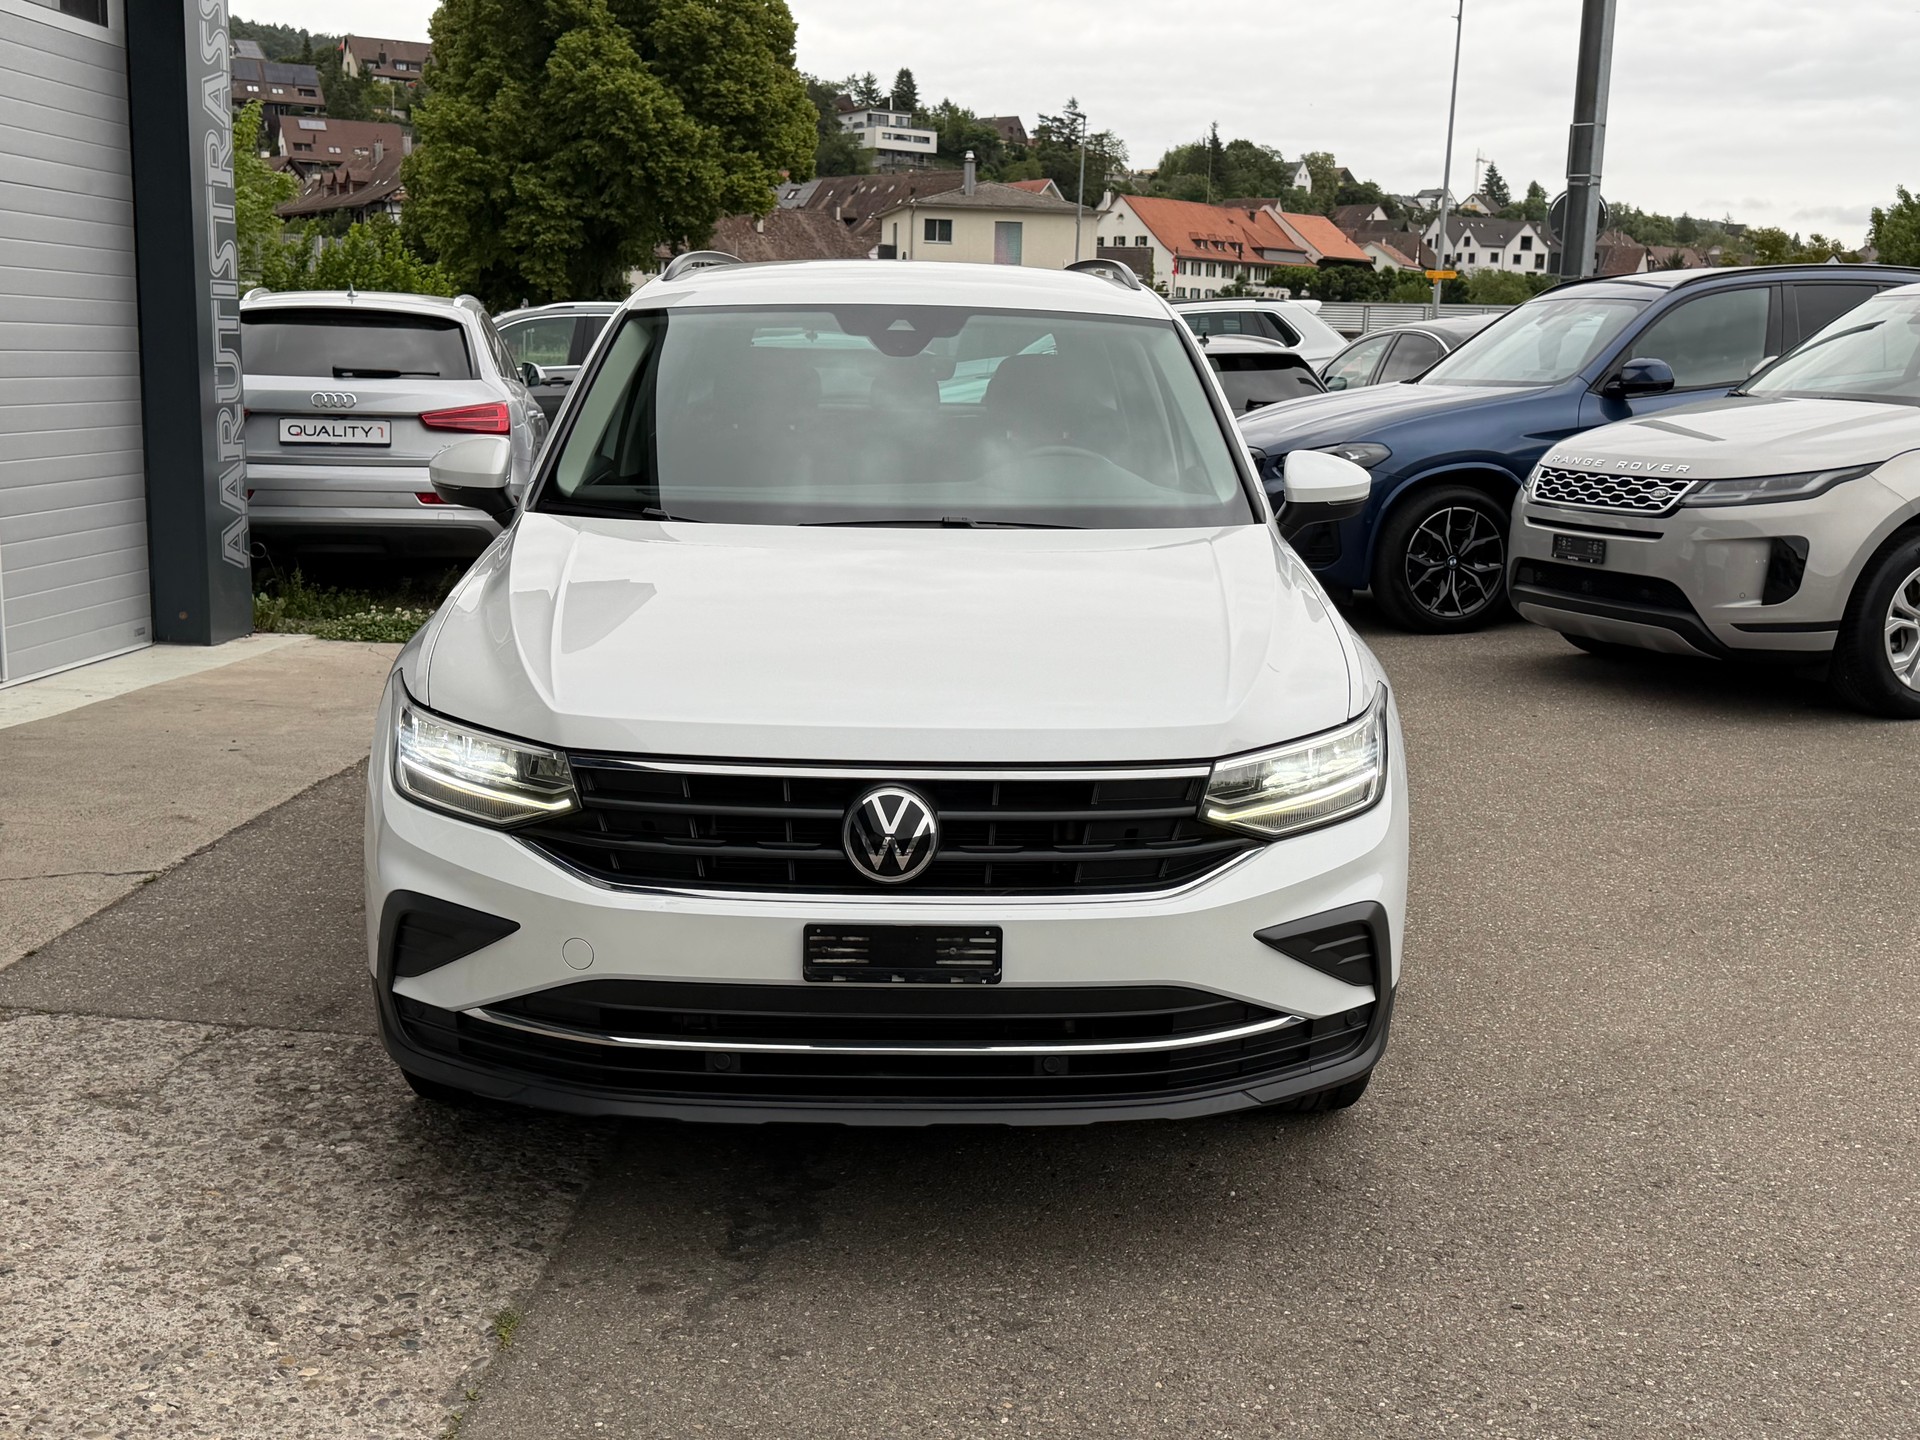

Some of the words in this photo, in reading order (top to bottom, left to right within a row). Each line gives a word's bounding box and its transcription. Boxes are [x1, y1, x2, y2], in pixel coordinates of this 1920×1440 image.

[287, 424, 373, 438] QUALITY
[377, 426, 384, 438] 1
[1551, 454, 1606, 467] RANGE
[1615, 460, 1691, 473] ROVER
[847, 788, 935, 874] VW
